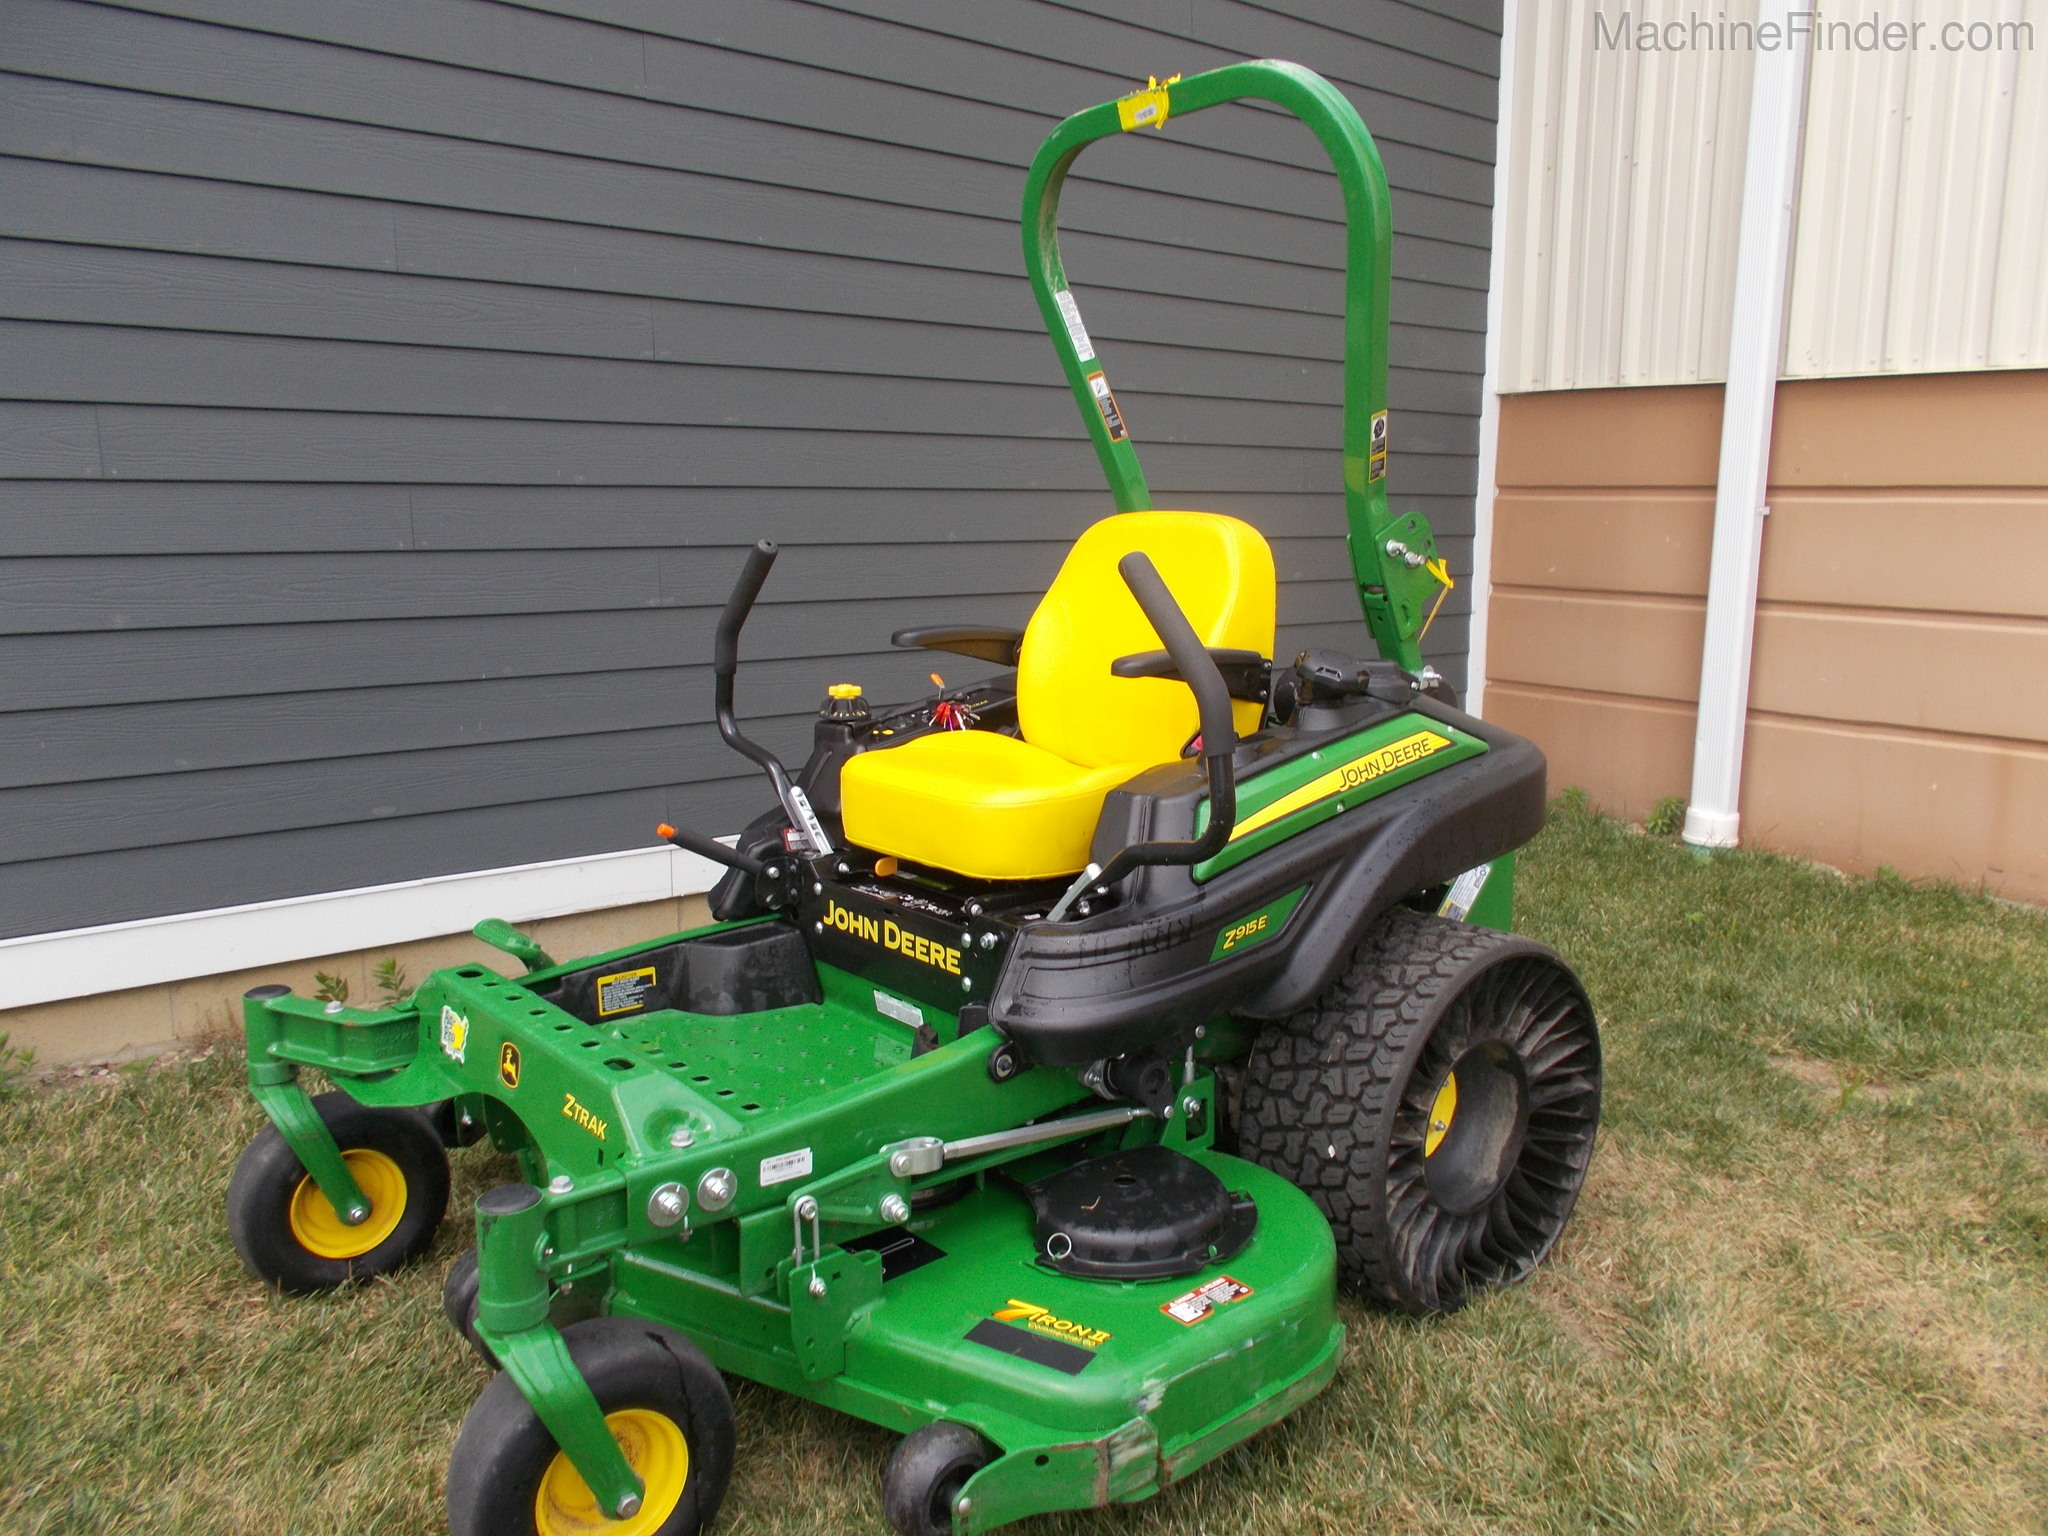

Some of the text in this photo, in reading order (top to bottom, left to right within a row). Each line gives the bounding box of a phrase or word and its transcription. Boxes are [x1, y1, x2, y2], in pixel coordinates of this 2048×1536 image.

[1340, 738, 1432, 788] JOHN DEERE
[823, 899, 879, 943] JOHN
[884, 919, 961, 975] DEERE
[1222, 914, 1268, 950] Z915E
[562, 1093, 608, 1141] ZTRAK
